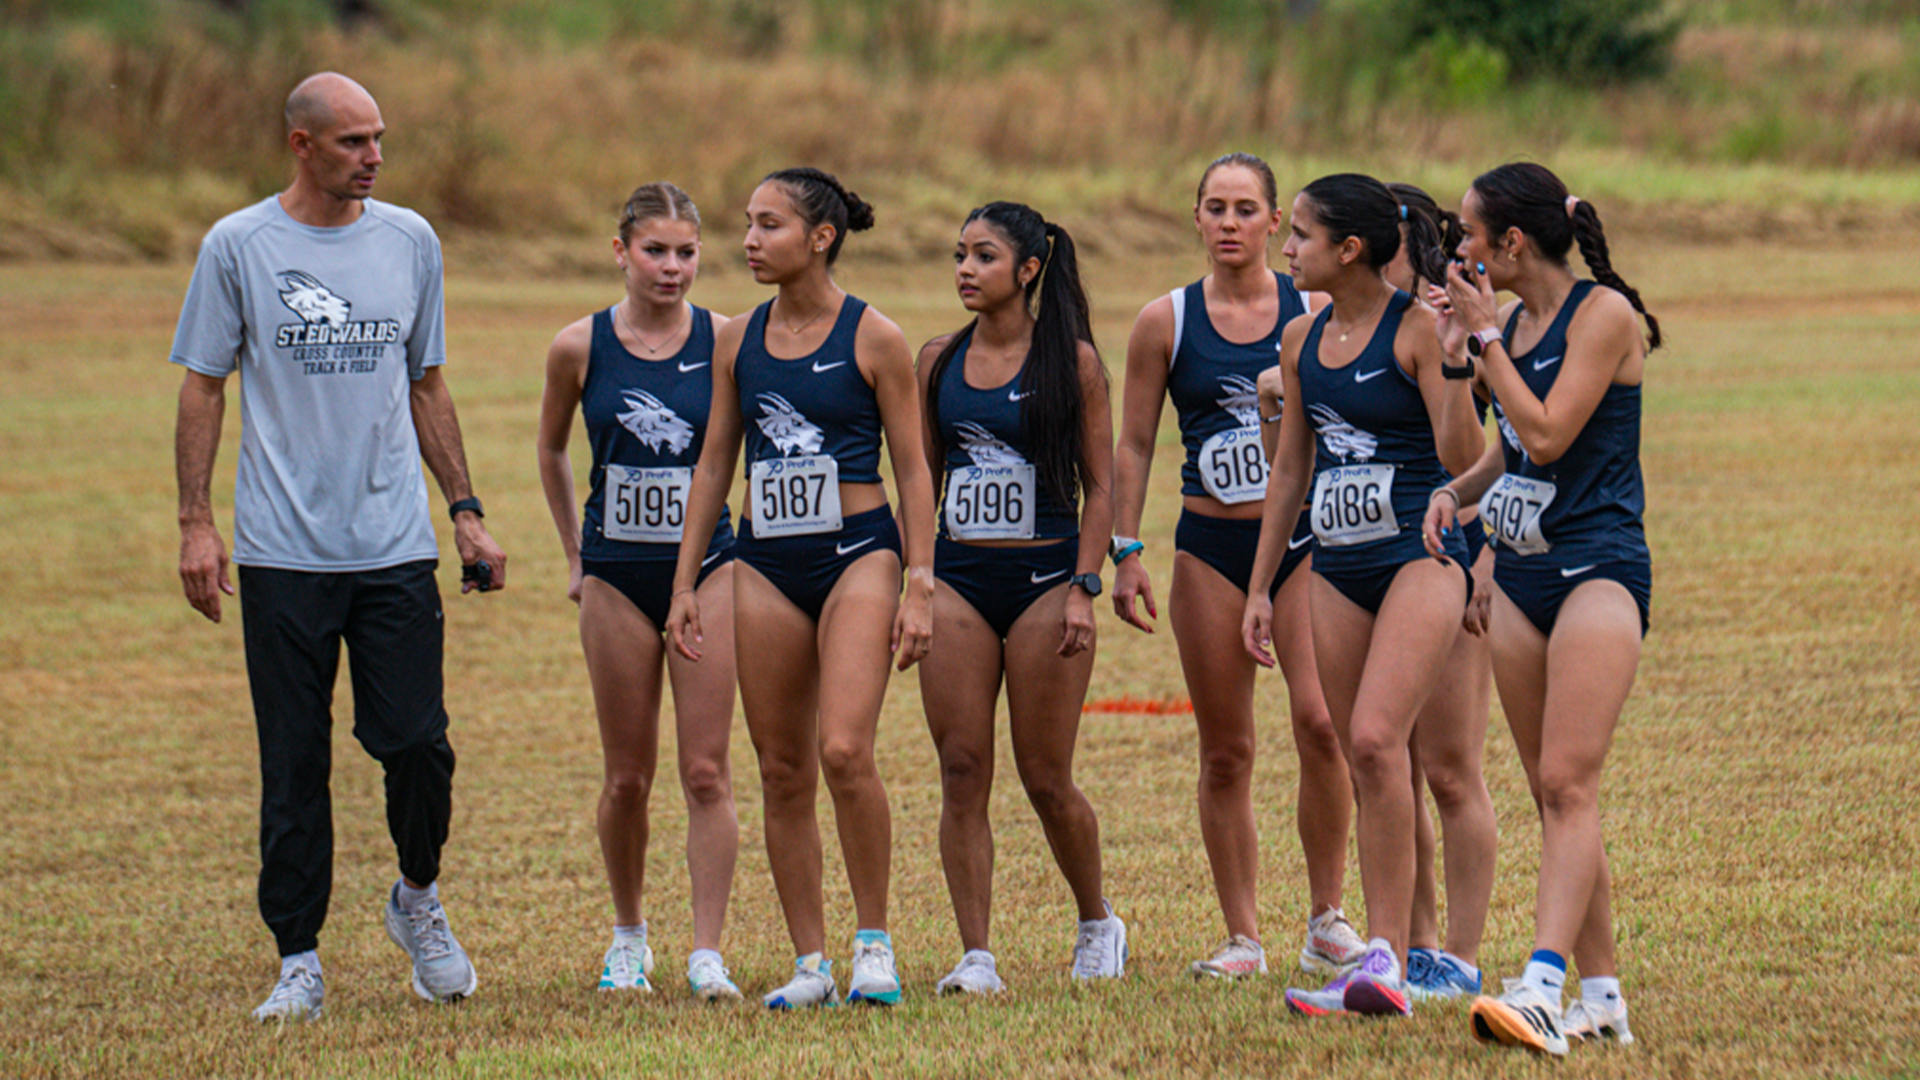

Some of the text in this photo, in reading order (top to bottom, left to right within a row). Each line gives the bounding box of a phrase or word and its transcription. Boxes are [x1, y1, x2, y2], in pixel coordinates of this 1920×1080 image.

[293, 345, 386, 360] CROSS COUNTRY
[304, 360, 377, 375] TRACK & FIELD
[645, 470, 673, 479] ProFit
[786, 459, 815, 469] ProFit
[985, 467, 1013, 476] ProFit
[1211, 442, 1271, 489] 518
[1343, 468, 1371, 477] ProFit
[616, 483, 683, 527] 5195
[762, 473, 826, 521] 5187
[955, 481, 1023, 525] 5196
[1320, 482, 1382, 531] 5186
[1487, 491, 1542, 542] 5197
